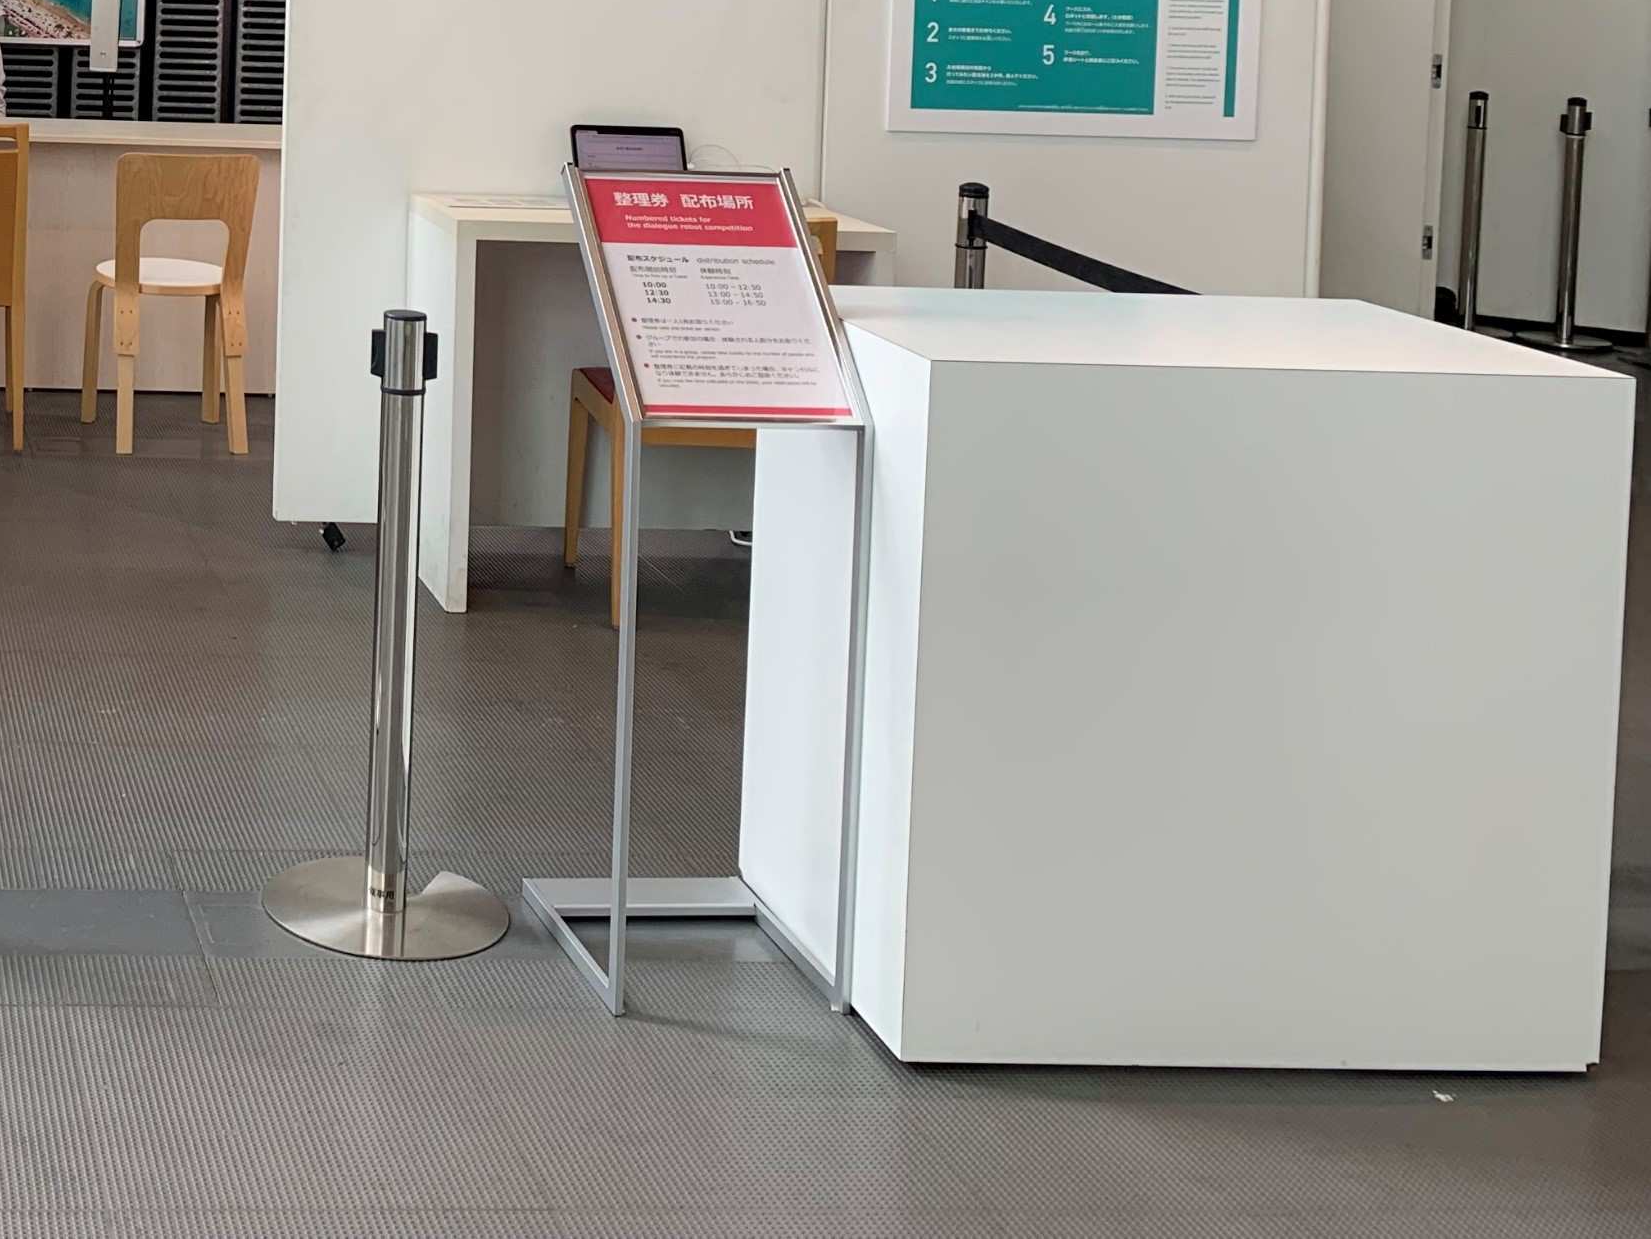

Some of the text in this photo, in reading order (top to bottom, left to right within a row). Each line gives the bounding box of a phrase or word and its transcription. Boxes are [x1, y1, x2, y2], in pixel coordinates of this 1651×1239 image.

[1043, 4, 1057, 25] 4
[926, 22, 939, 43] 2
[1043, 44, 1055, 65] 5
[925, 62, 938, 83] 3
[613, 191, 754, 210] 整理券 配布場所
[670, 215, 697, 223] tickets
[704, 224, 753, 232] competition
